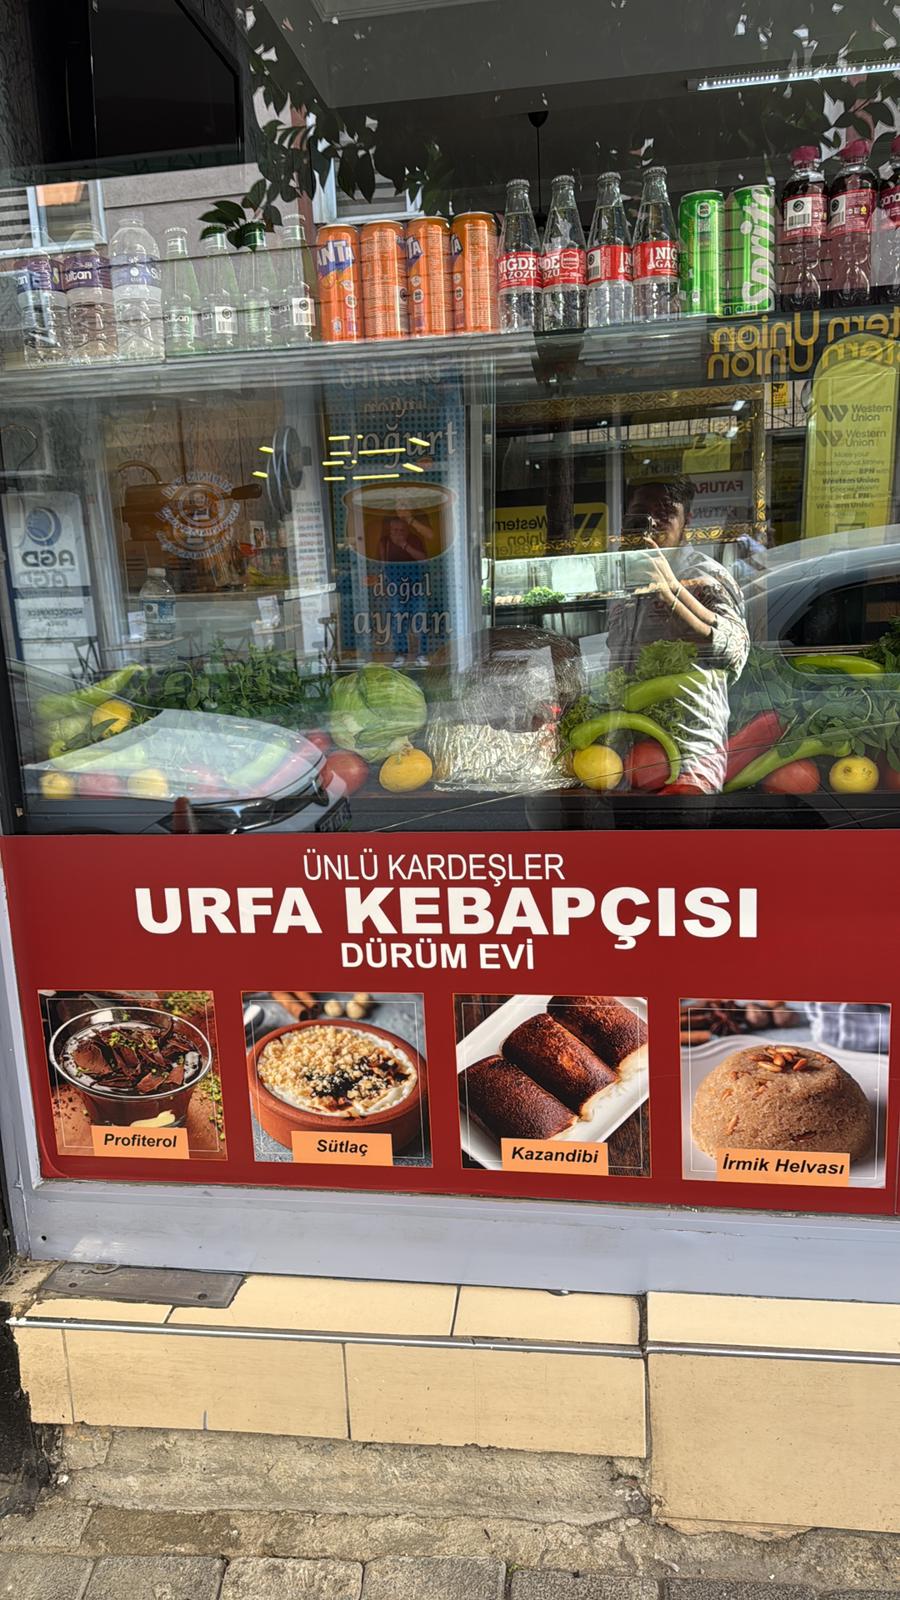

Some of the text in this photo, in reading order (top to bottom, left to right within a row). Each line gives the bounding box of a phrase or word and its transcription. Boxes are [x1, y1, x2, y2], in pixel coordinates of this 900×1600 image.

[851, 404, 892, 412] Western
[851, 413, 880, 422] Union
[342, 421, 458, 469] yoğurt
[373, 572, 432, 604] doğal
[353, 609, 453, 645] ayran
[303, 848, 566, 887] ÜNLÜ KARDEŞLER
[135, 886, 758, 950] URFA KEBAPÇISI
[341, 938, 535, 970] DÜRÜM EVİ
[103, 1133, 178, 1148] Profiterol
[316, 1139, 369, 1157] Sütlaç
[511, 1146, 600, 1164] Kazandibi
[722, 1153, 845, 1176] İrmik Helvası
